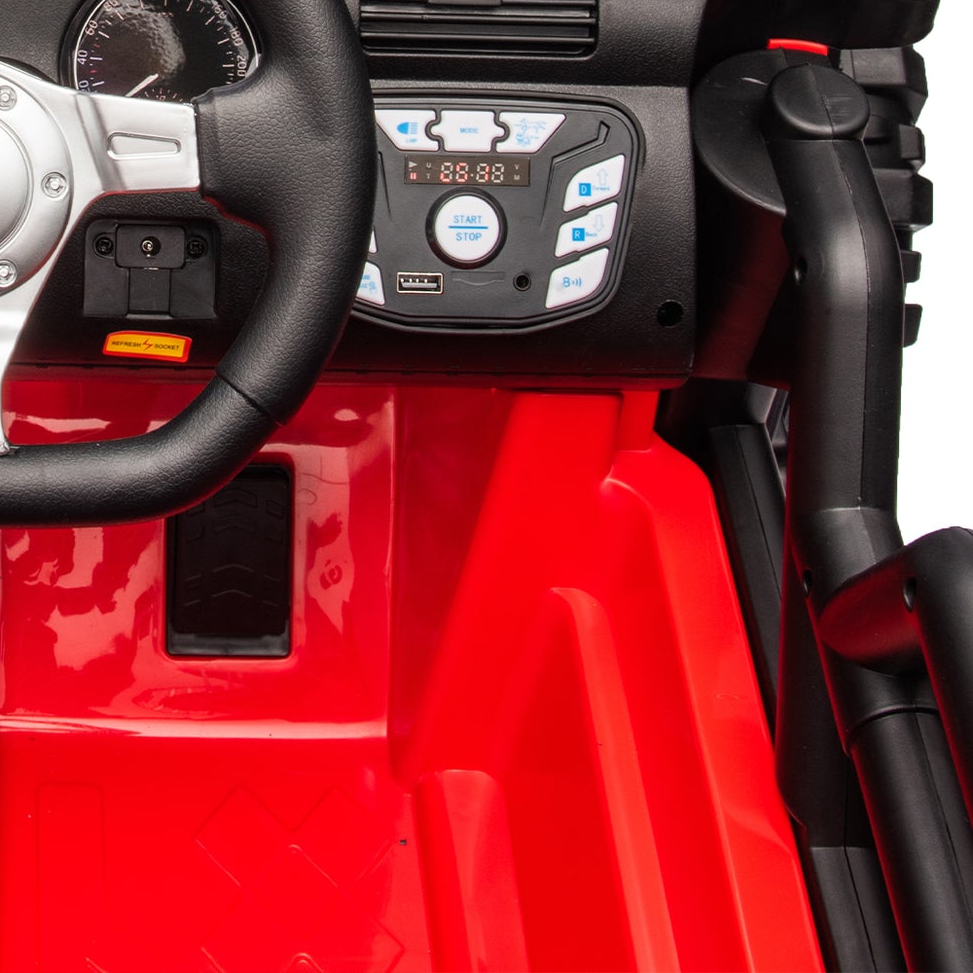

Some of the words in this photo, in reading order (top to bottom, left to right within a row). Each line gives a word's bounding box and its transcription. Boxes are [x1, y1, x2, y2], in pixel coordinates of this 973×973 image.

[212, 3, 227, 19] 160
[85, 20, 98, 36] 60
[229, 27, 244, 46] 180
[77, 50, 88, 65] 40
[237, 55, 247, 77] 200
[581, 184, 587, 194] D
[453, 215, 483, 224] START
[455, 232, 482, 241] STOP
[574, 231, 580, 240] R
